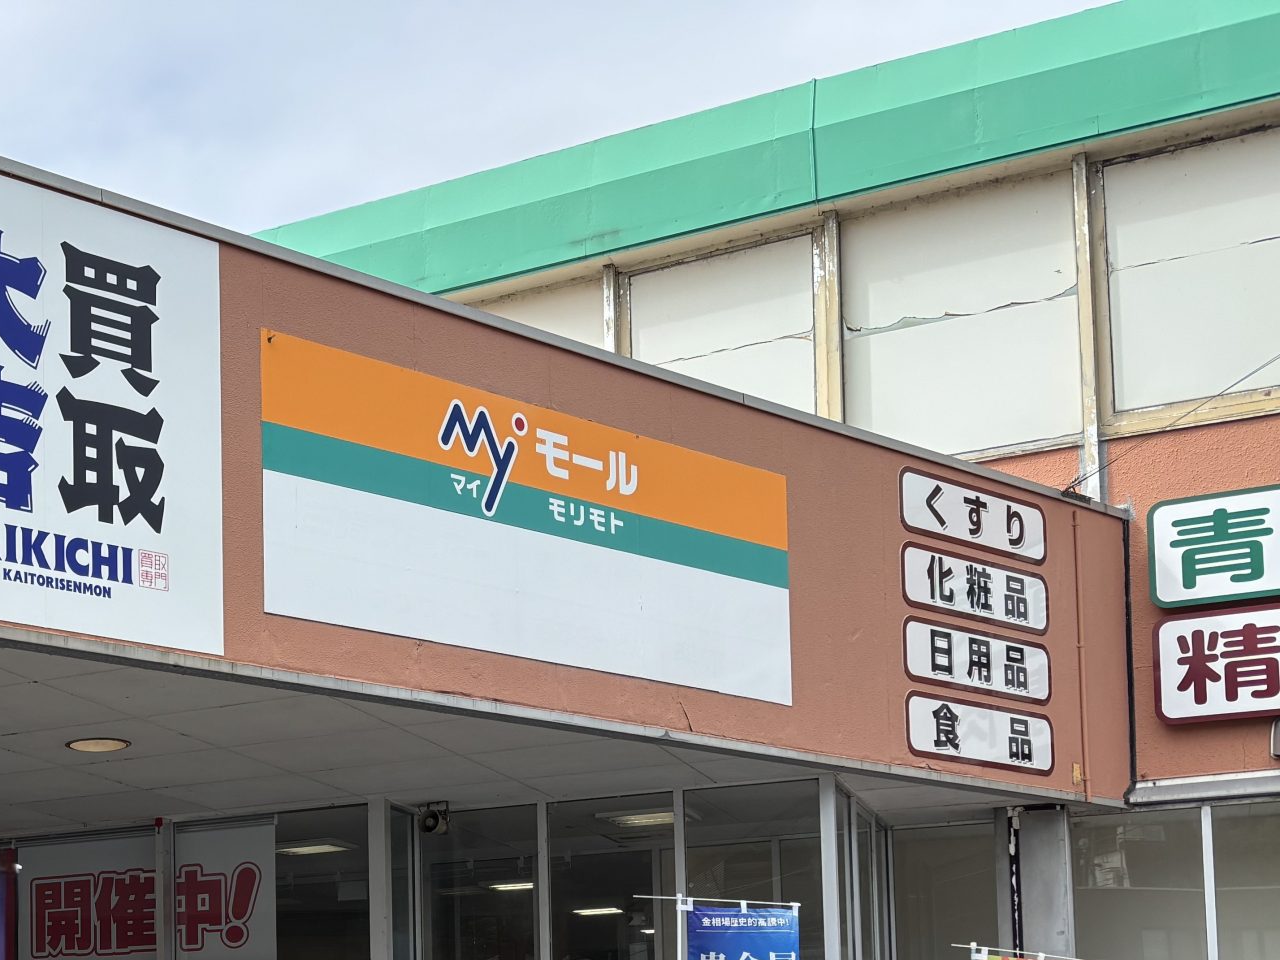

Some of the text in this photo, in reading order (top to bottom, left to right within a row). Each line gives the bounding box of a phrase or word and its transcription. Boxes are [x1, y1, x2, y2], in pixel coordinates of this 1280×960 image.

[56, 241, 166, 534] 買取
[450, 473, 481, 498] マイ
[535, 427, 638, 496] モール
[549, 498, 624, 534] モリモト
[925, 484, 1026, 548] くすり
[1170, 508, 1274, 590] 青
[2, 568, 112, 599] KAITORISENMON
[927, 555, 1029, 622] 化粧品
[930, 629, 1029, 692] 日用品
[1177, 623, 1280, 705] 精
[932, 703, 1034, 764] 食品
